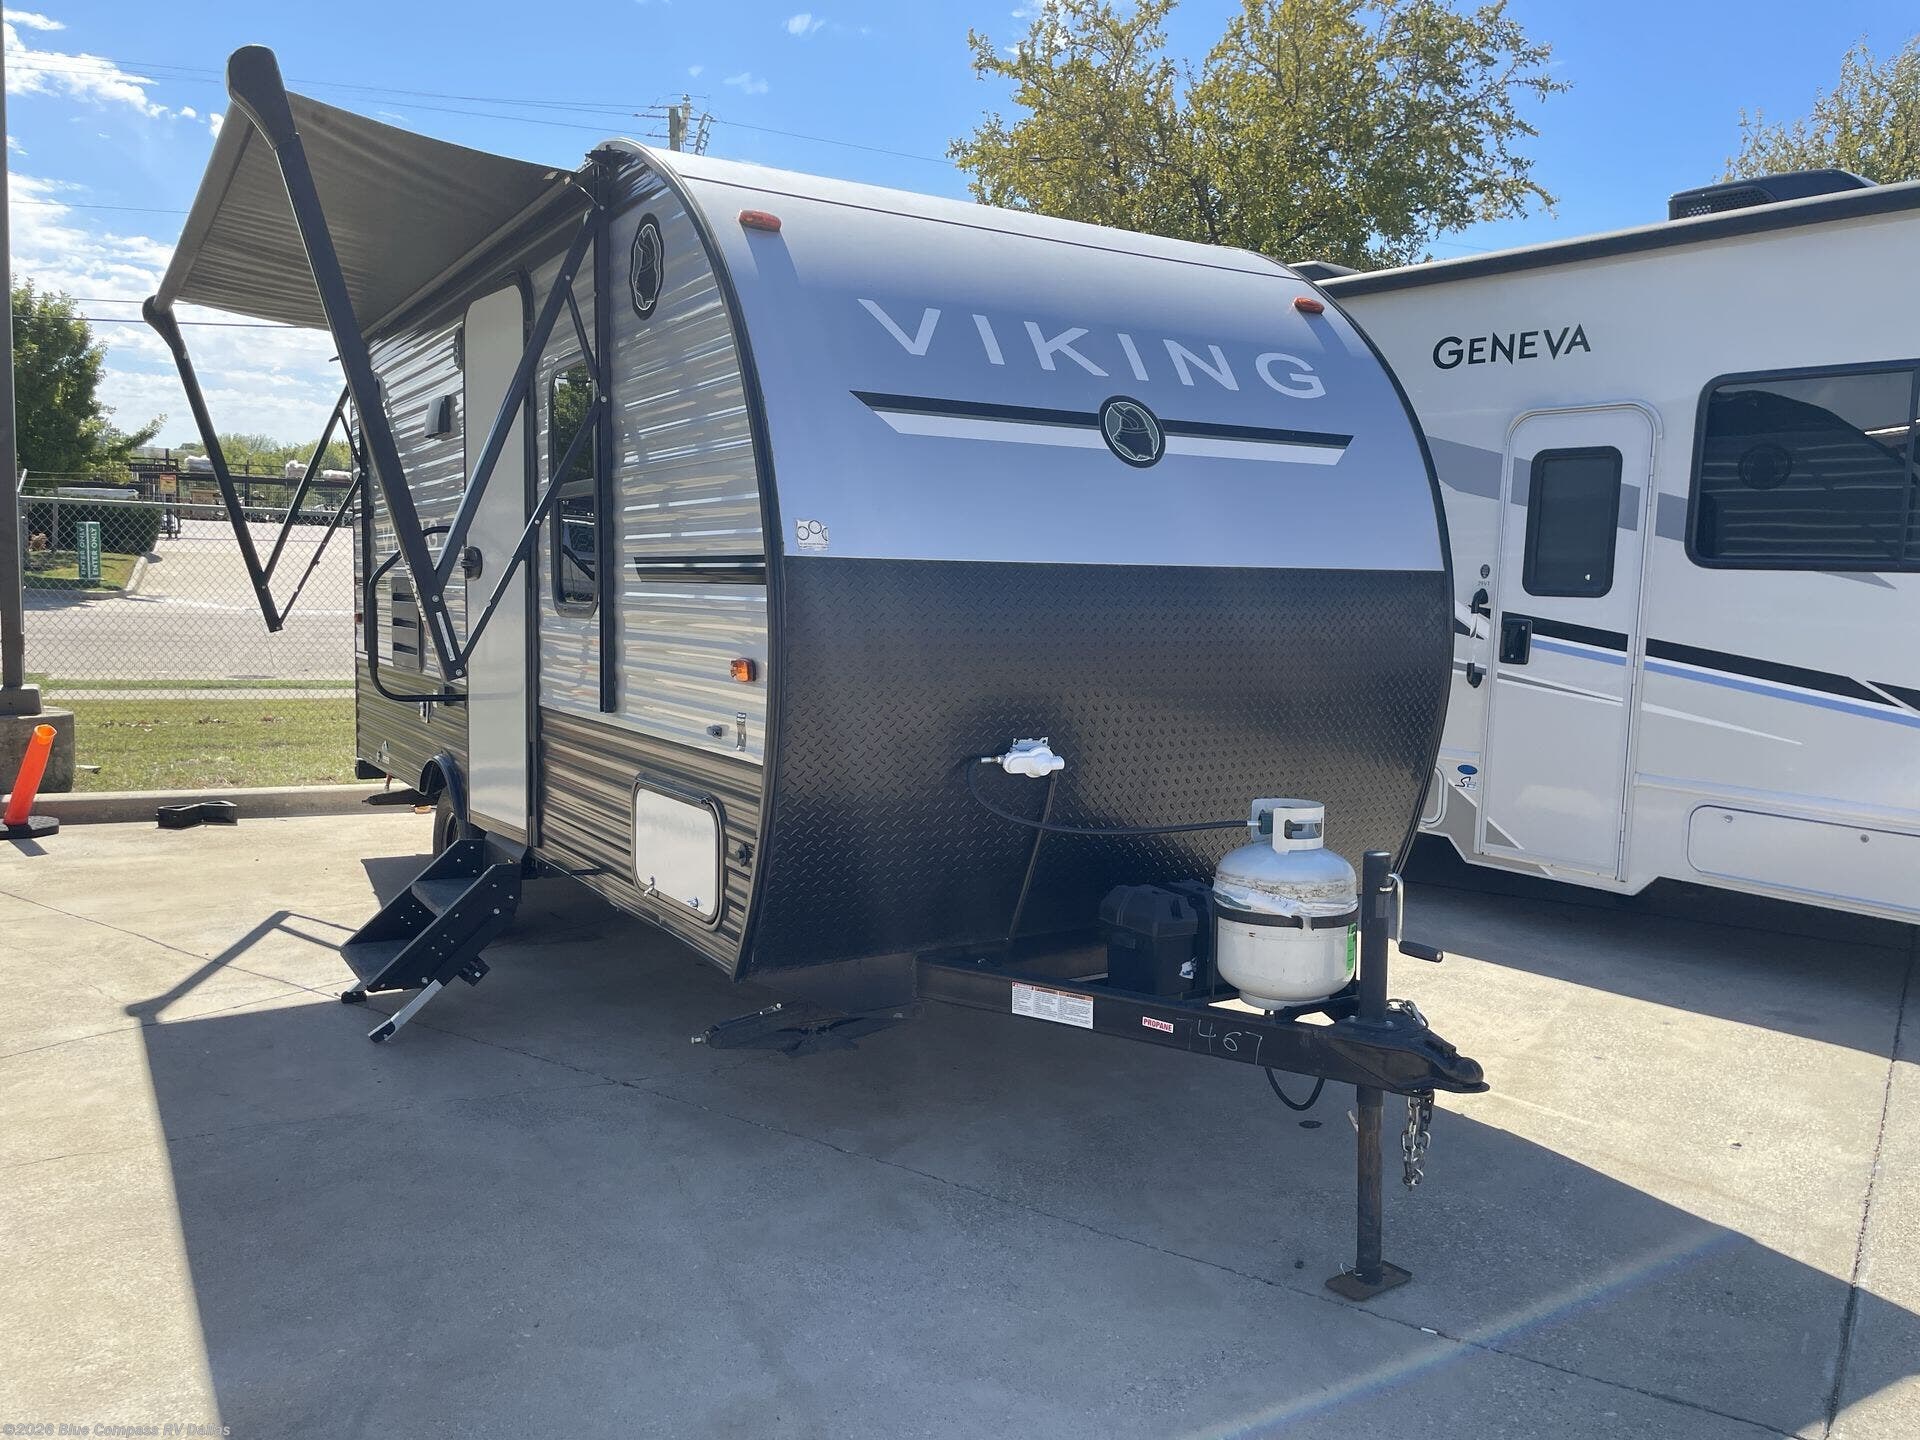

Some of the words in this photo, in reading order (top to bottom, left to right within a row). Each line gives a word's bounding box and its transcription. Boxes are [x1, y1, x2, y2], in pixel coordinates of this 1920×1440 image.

[858, 298, 1327, 399] VIKING
[1432, 323, 1591, 370] GENEVA
[90, 527, 98, 549] ONLY
[91, 550, 99, 575] ENTER
[1143, 1017, 1172, 1032] PROPANE
